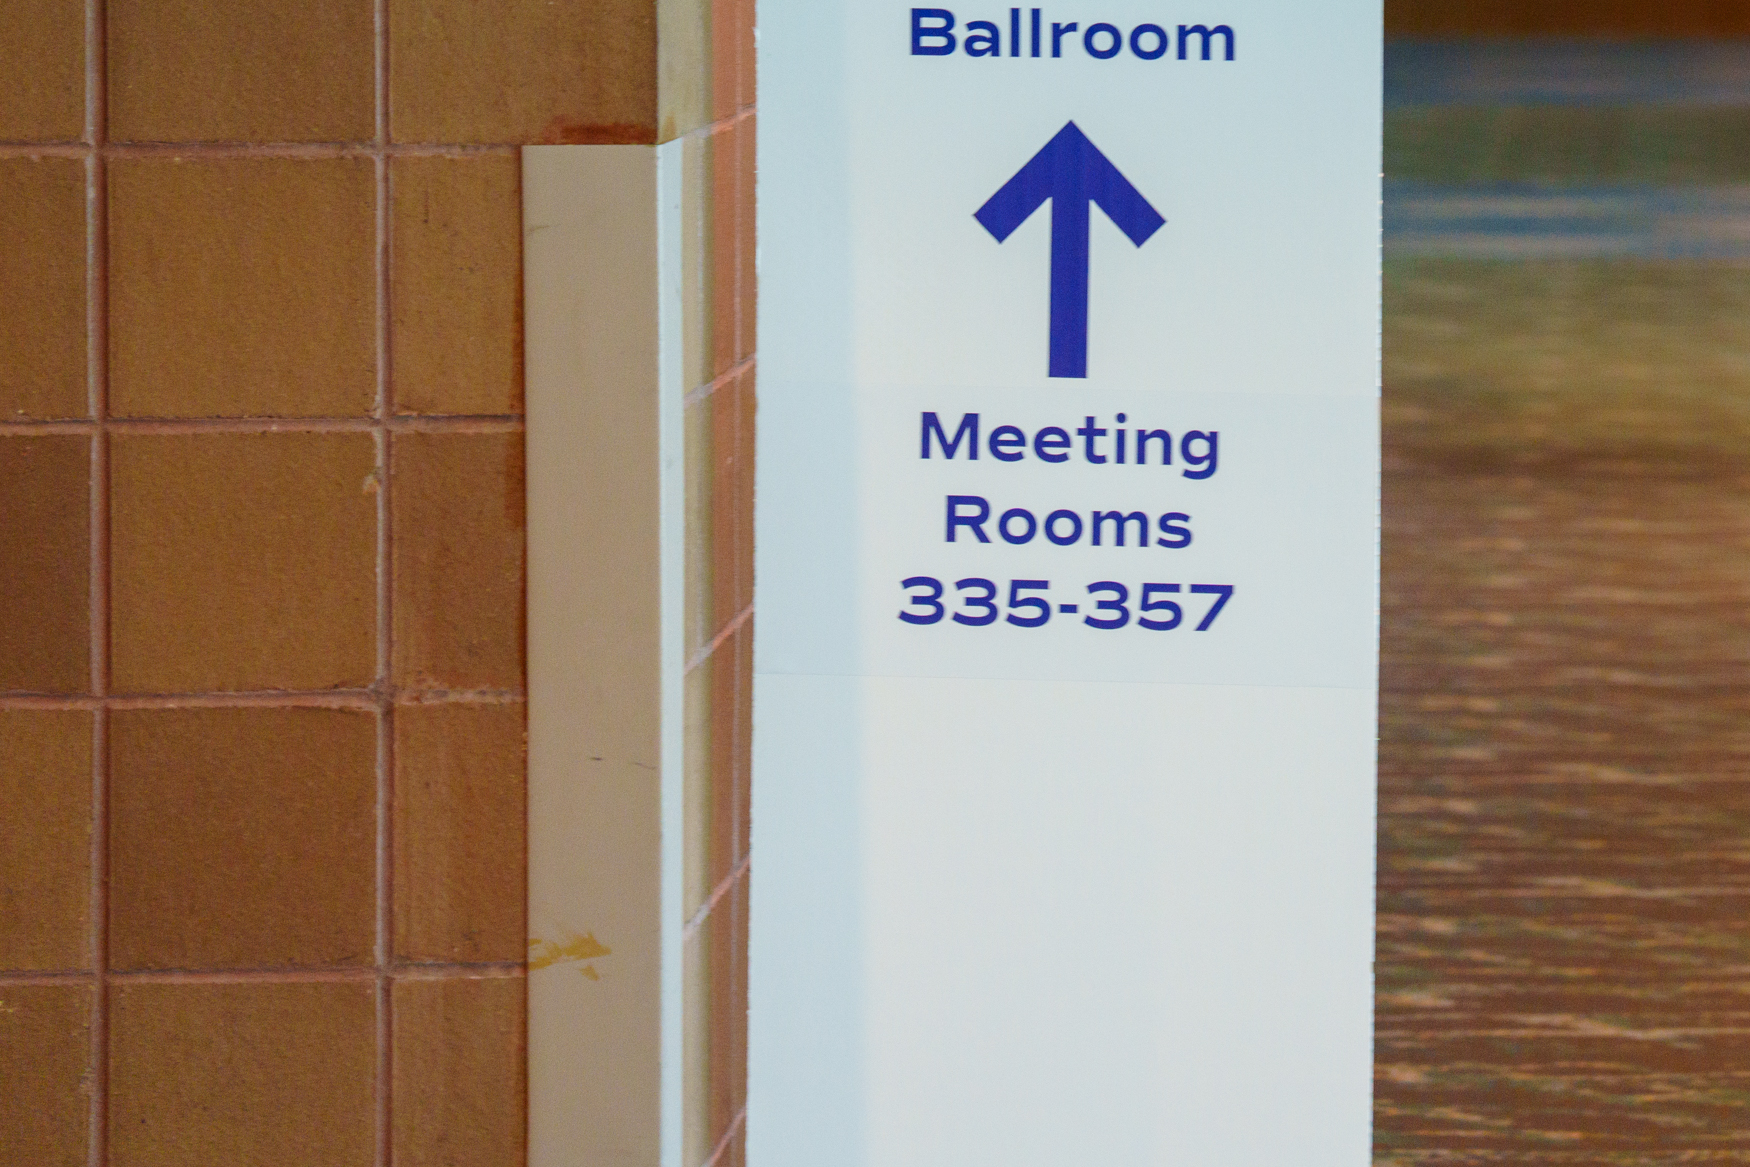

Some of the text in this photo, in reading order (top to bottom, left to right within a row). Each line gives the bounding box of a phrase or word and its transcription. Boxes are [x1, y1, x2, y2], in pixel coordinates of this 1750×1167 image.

[910, 7, 1236, 62] Ballroom
[920, 411, 1218, 481] Meeting
[945, 495, 1193, 549] Rooms
[897, 576, 1235, 632] 335-357
